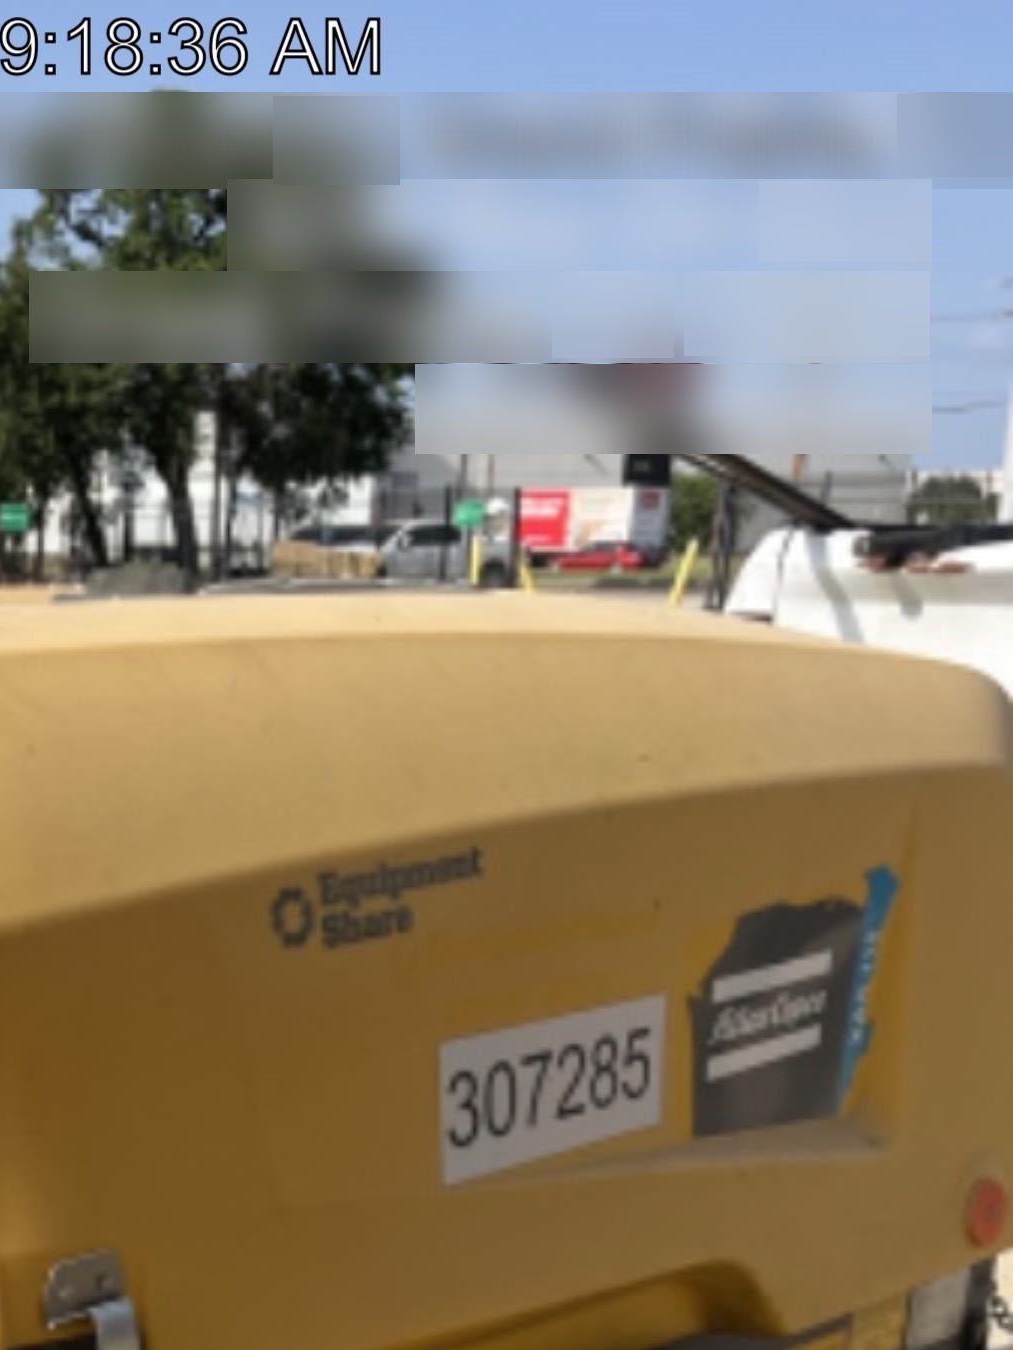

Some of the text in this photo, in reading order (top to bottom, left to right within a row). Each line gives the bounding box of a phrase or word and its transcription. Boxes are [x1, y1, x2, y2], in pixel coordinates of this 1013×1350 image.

[318, 845, 484, 909] Equipment
[321, 904, 414, 949] Share
[446, 1025, 654, 1150] 307285
